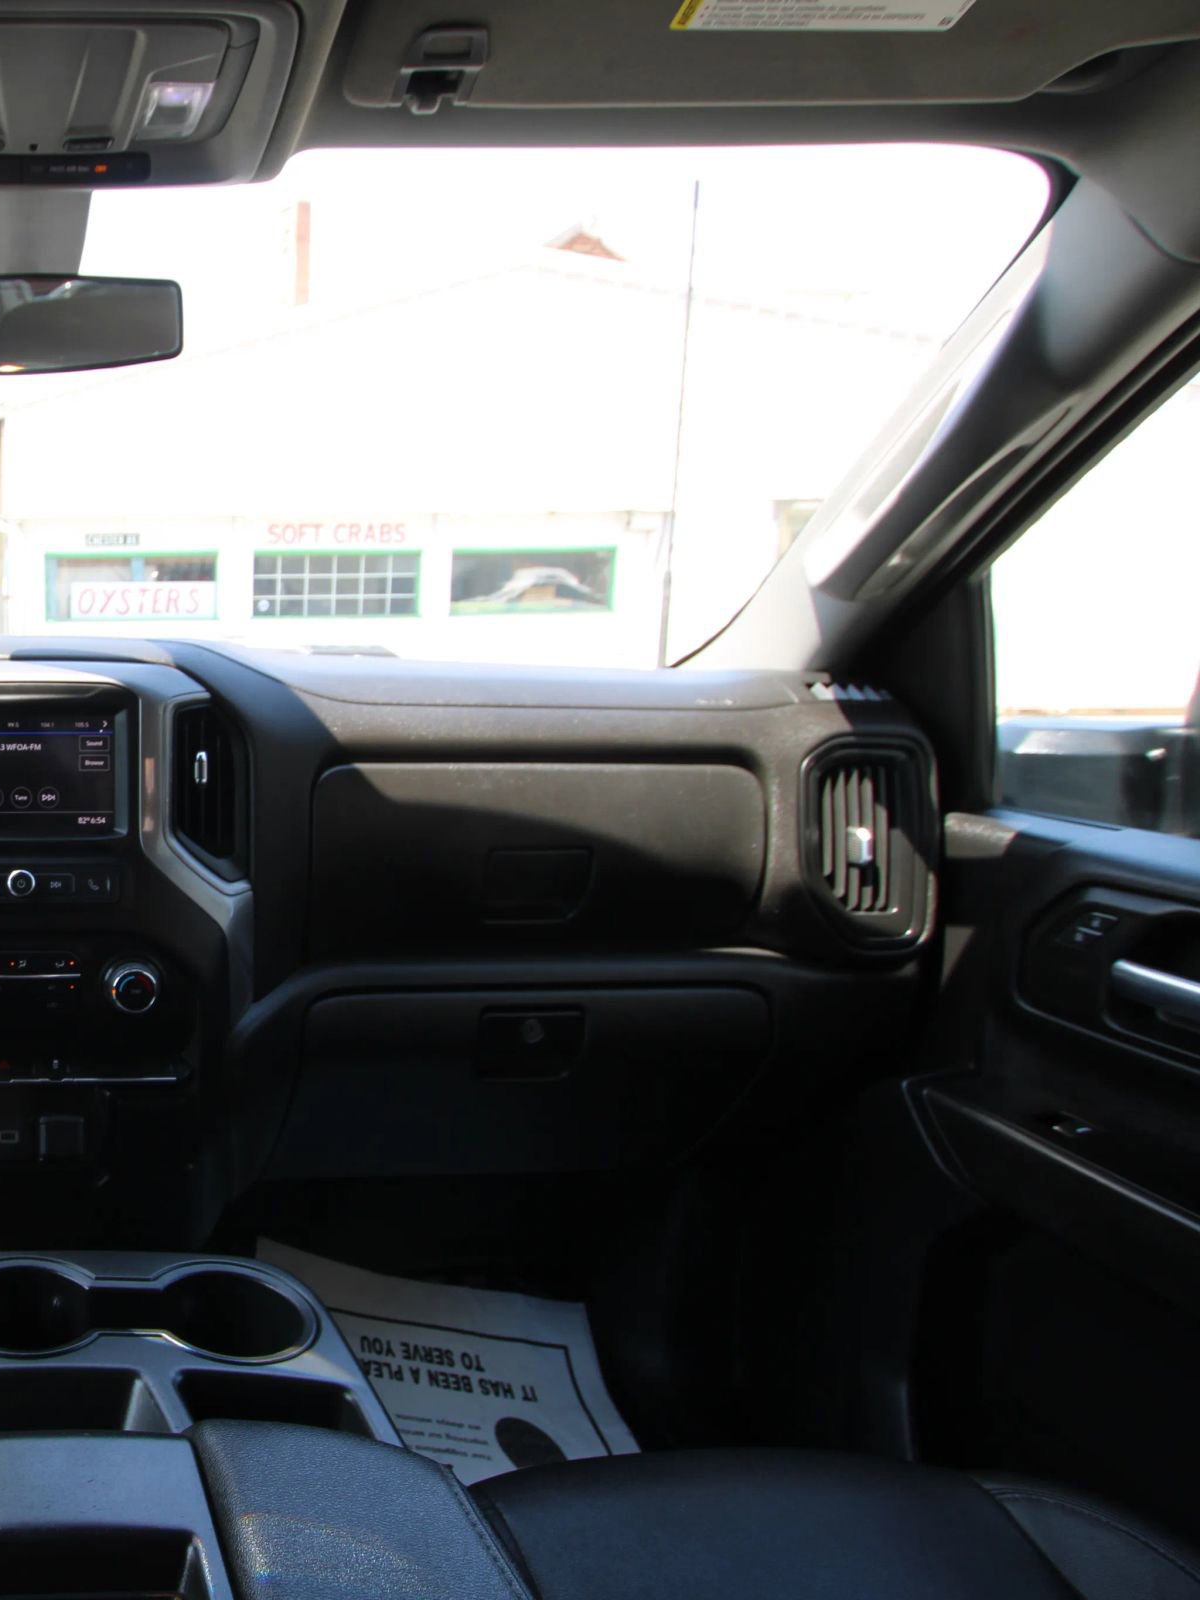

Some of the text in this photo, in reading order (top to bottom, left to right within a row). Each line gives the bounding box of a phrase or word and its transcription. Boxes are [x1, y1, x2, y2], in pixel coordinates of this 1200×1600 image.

[267, 523, 406, 544] SOFT CRABS
[78, 588, 200, 615] OYSTERS
[360, 1335, 486, 1373] TO SERVE YOU
[412, 1367, 421, 1384] A
[428, 1369, 473, 1394] BEEN
[480, 1380, 515, 1400] HAS
[521, 1386, 538, 1402] IT
